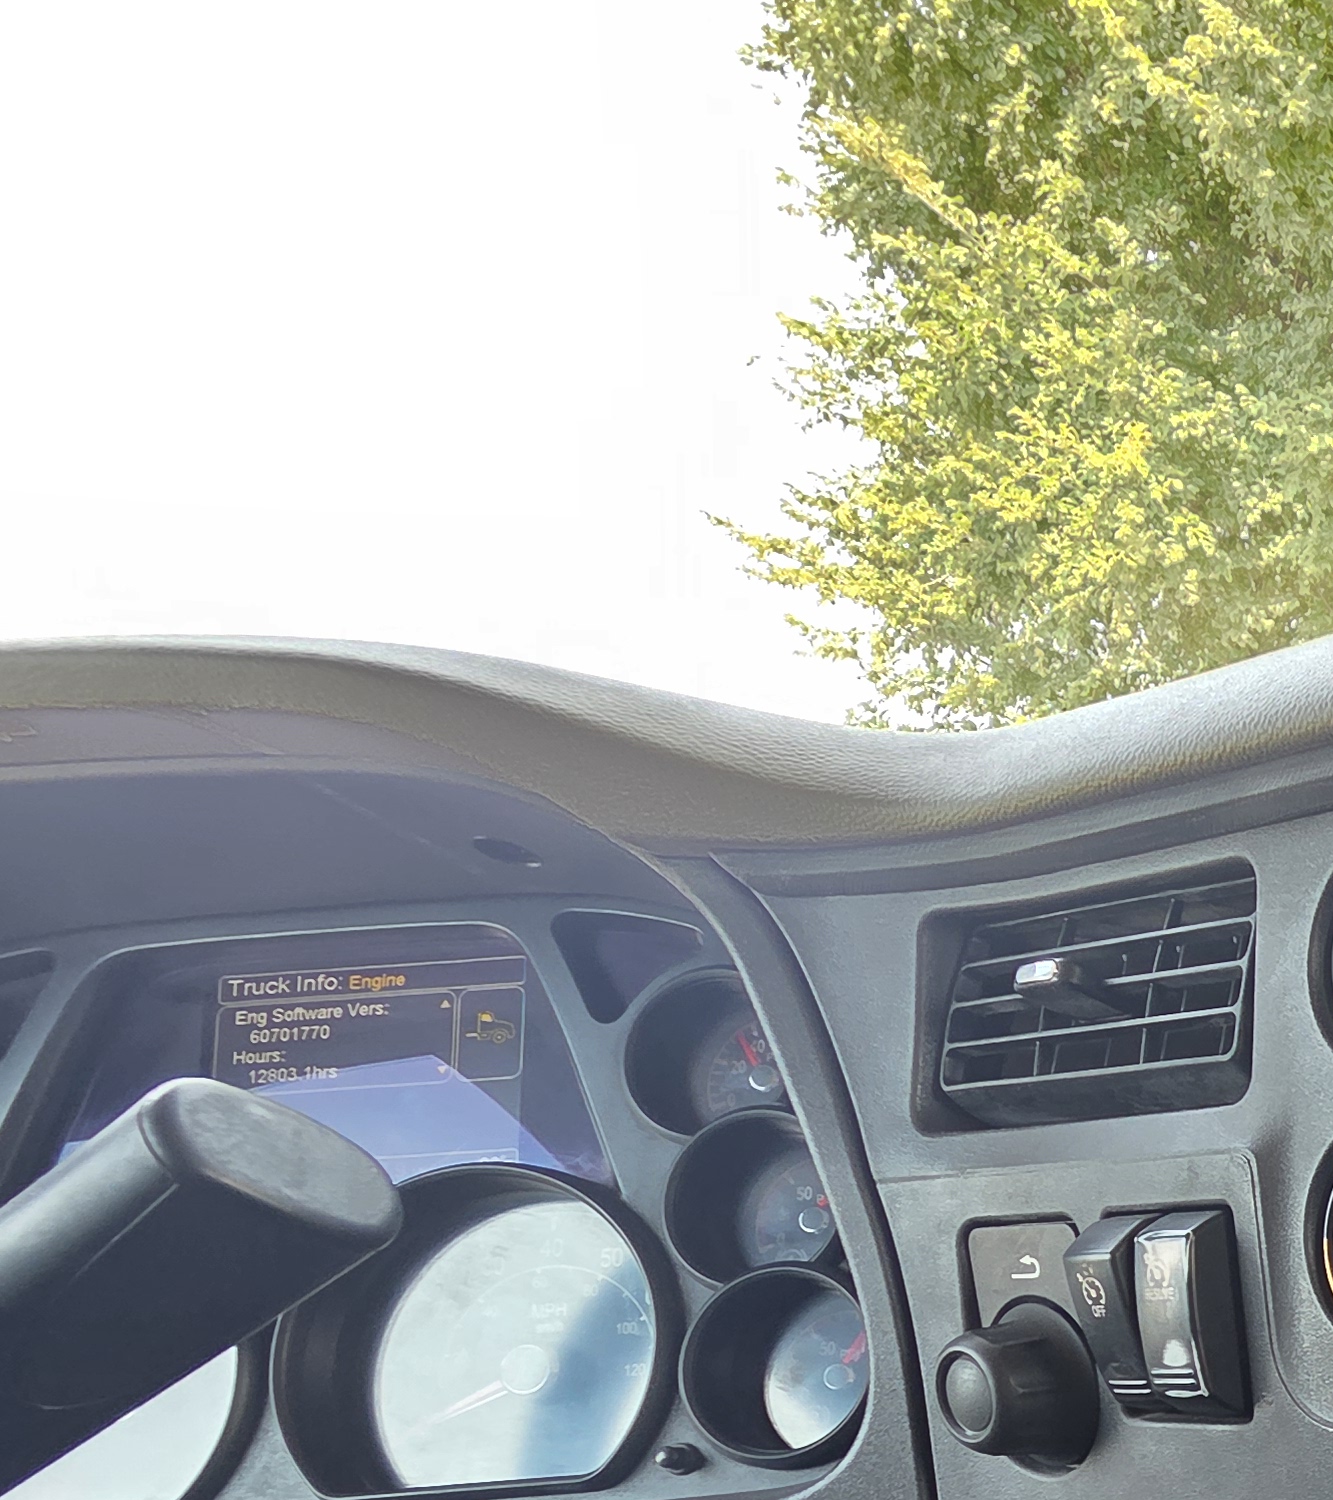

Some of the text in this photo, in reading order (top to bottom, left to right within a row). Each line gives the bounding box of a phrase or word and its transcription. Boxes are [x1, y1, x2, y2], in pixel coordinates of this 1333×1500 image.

[228, 973, 406, 997] Truck Info: Engine
[235, 1003, 390, 1028] Eng Software Vers:
[249, 1025, 331, 1043] 60701770
[232, 1049, 287, 1065] Hours:
[796, 1186, 813, 1201] 50
[600, 1247, 623, 1268] 50
[616, 1321, 638, 1335] 100
[624, 1362, 646, 1377] 120
